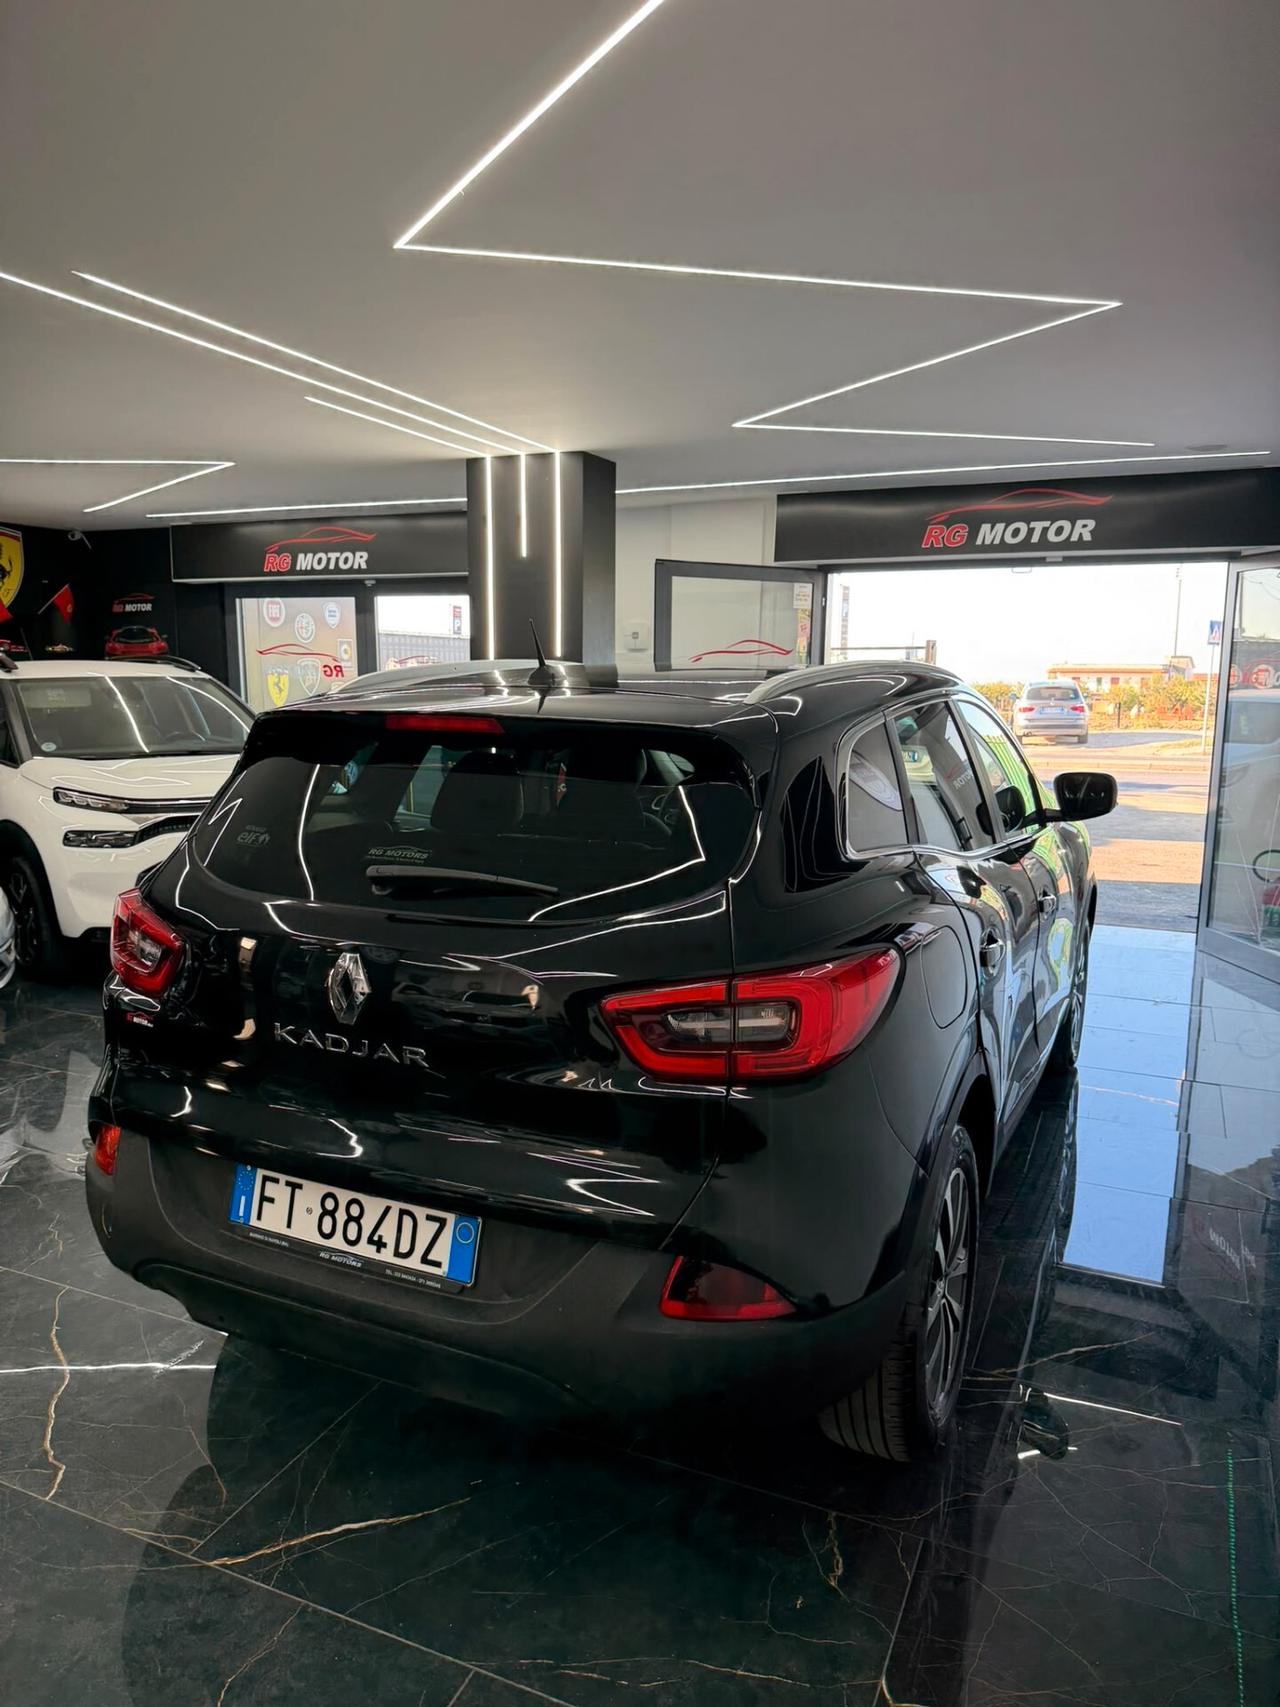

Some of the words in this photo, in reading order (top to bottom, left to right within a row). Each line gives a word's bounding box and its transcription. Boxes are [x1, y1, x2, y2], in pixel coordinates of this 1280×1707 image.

[921, 524, 969, 548] RG
[975, 519, 1096, 546] MOTOR
[263, 553, 292, 572] RG
[296, 551, 369, 571] MOTOR
[125, 603, 152, 612] MOTOR
[384, 850, 429, 859] MOTORS
[274, 1022, 430, 1068] KADJAR
